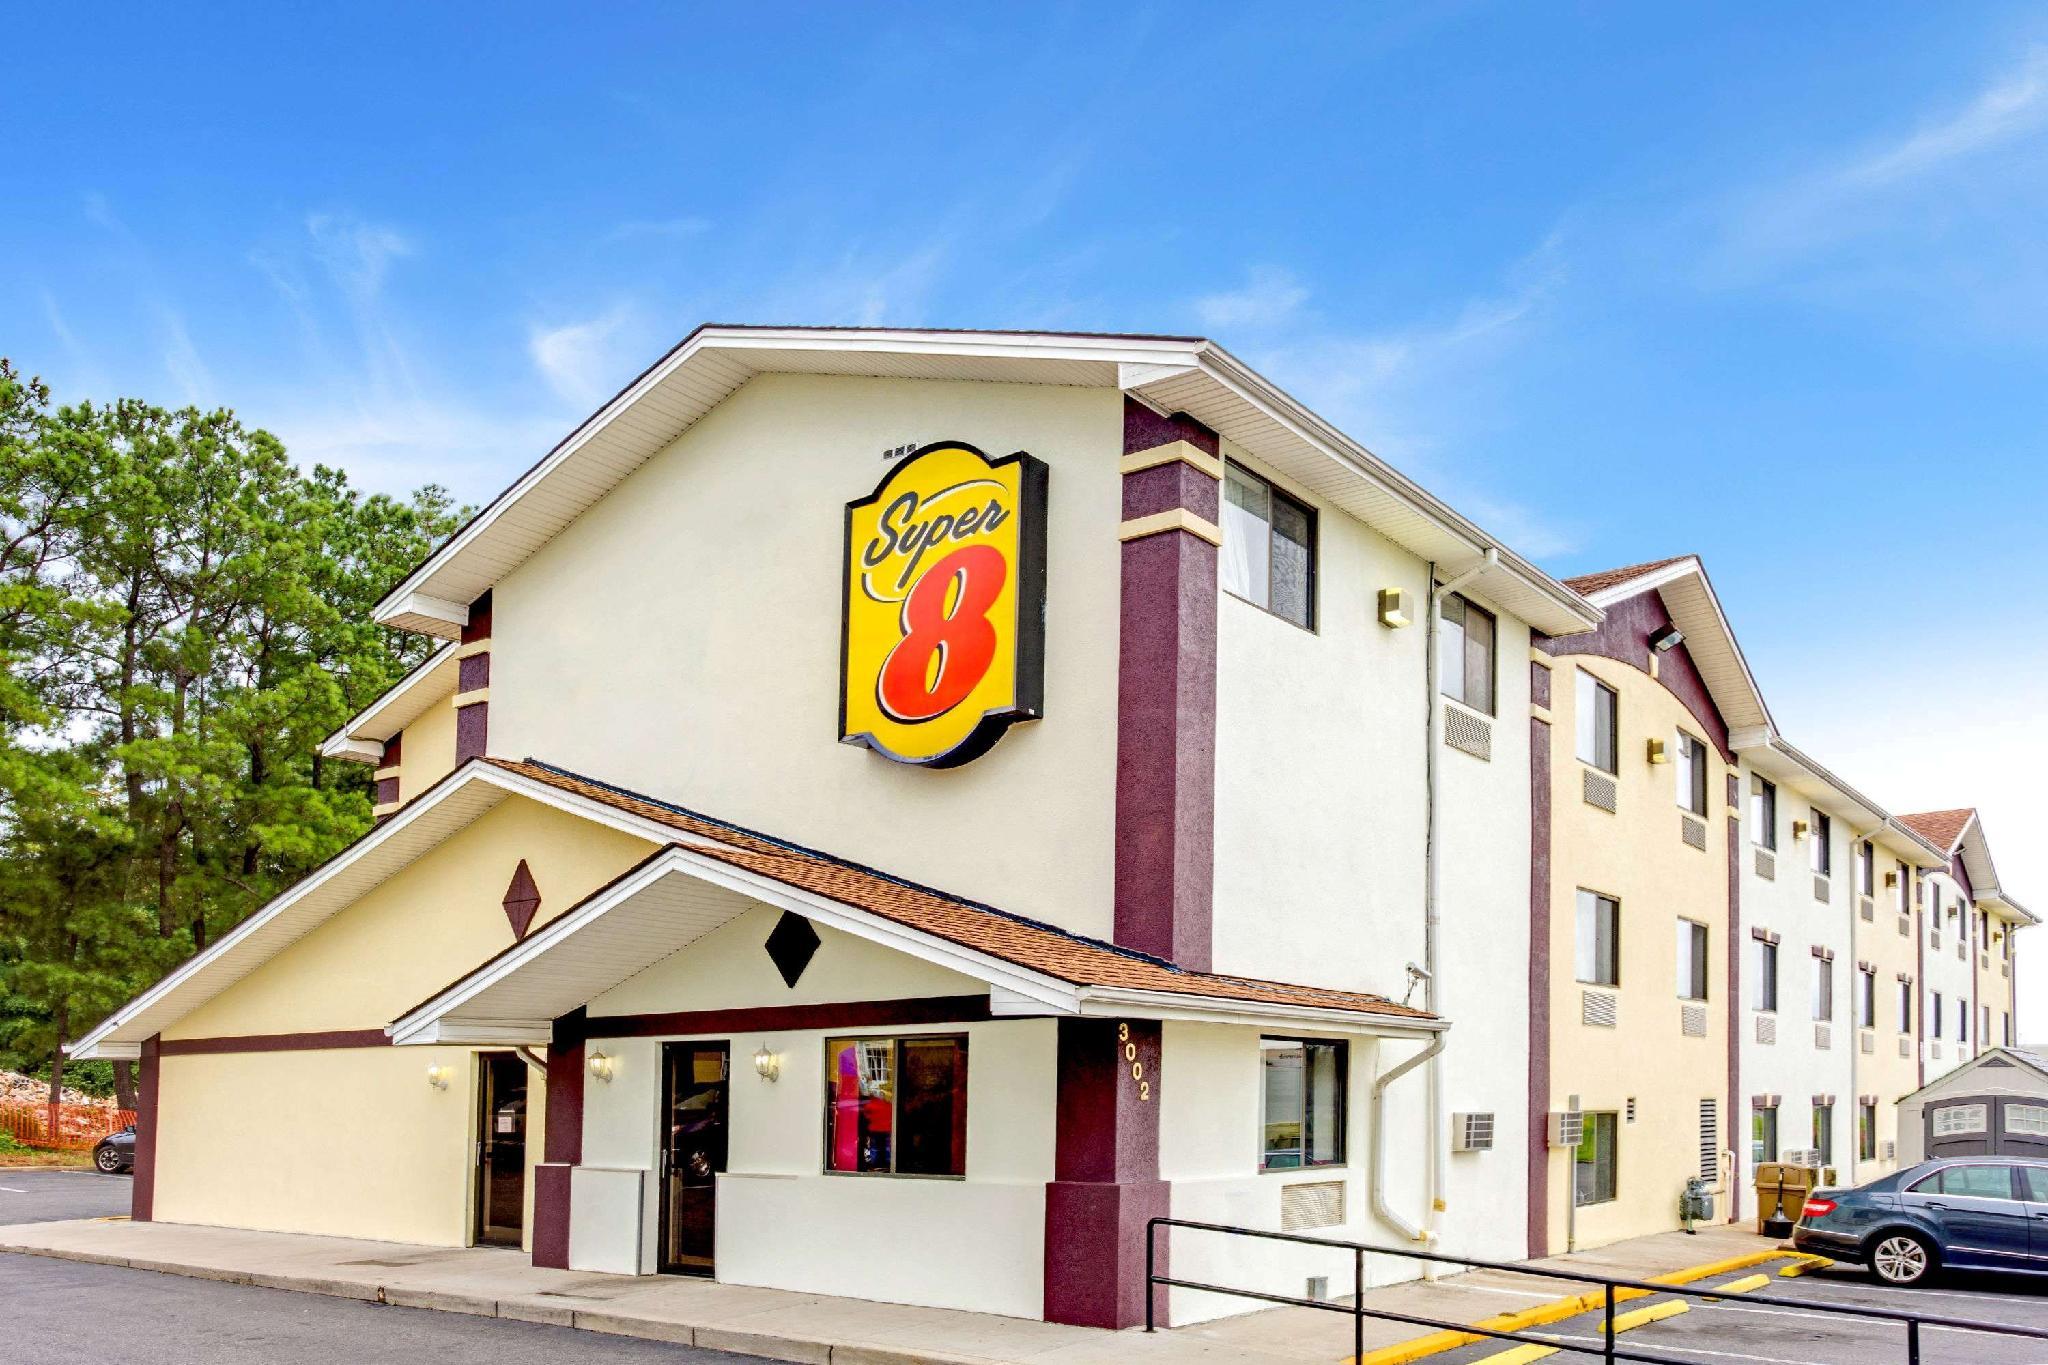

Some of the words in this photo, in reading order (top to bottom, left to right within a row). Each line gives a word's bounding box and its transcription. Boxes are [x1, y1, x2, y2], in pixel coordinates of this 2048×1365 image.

[862, 491, 1010, 591] Super
[876, 544, 1007, 724] 8
[1118, 1022, 1149, 1101] 3002
